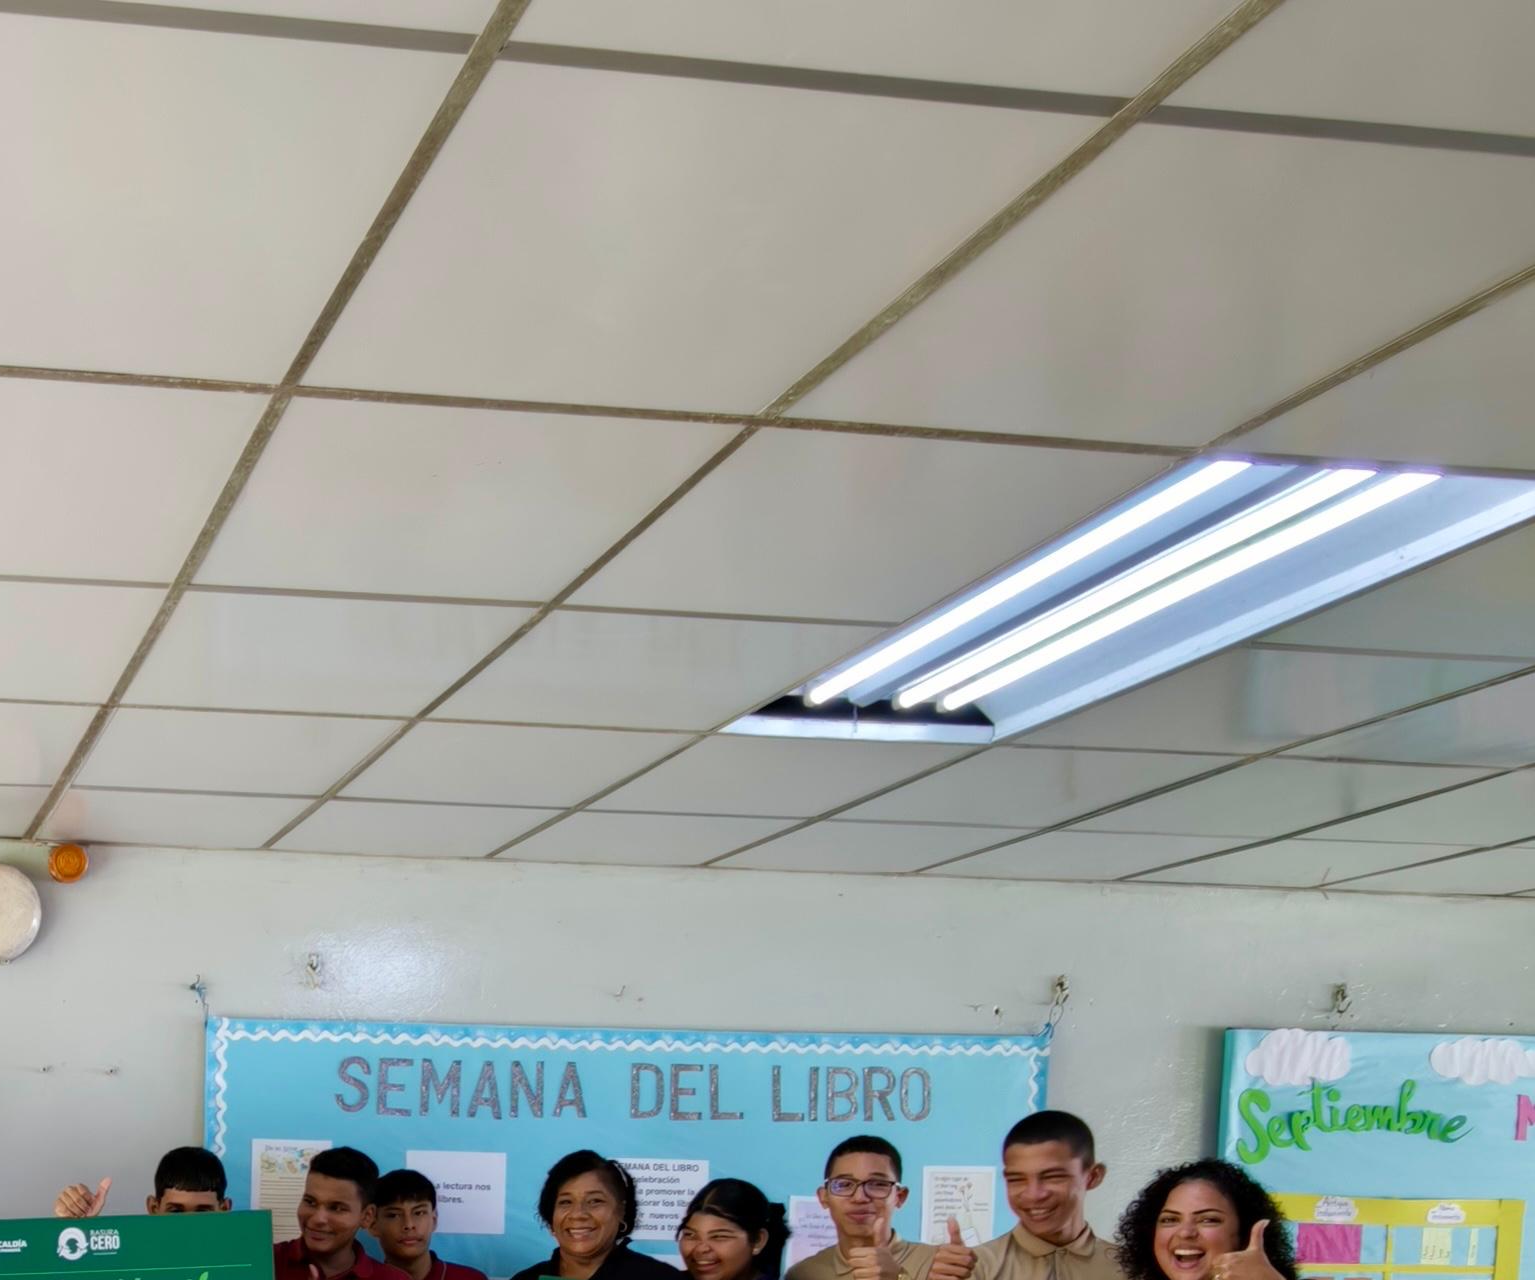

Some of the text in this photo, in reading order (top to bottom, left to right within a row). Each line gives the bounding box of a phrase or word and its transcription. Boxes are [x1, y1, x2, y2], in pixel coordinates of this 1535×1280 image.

[334, 1056, 932, 1122] SEMANA DEL LIBRO
[1236, 1078, 1475, 1165] Septiembre
[653, 1163, 670, 1171] DEL
[673, 1164, 700, 1172] LIBRO
[443, 1181, 473, 1190] lectura
[90, 1235, 120, 1250] CERO
